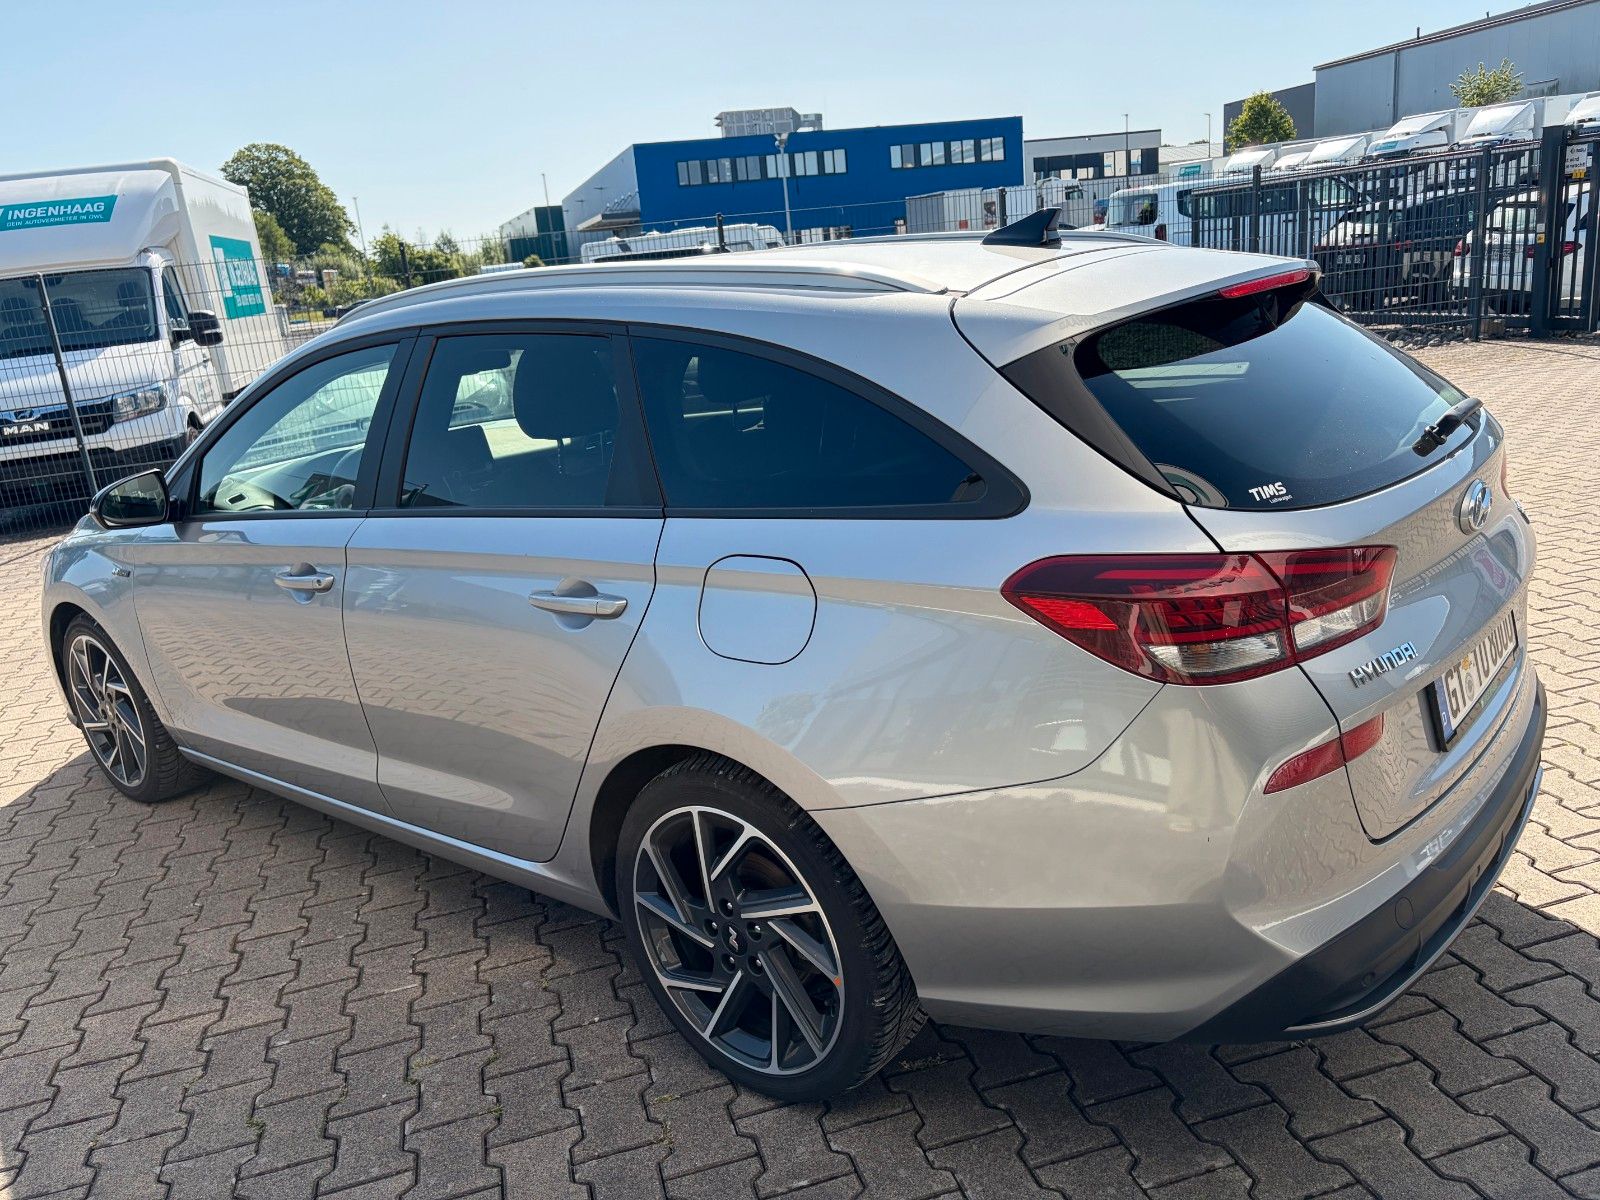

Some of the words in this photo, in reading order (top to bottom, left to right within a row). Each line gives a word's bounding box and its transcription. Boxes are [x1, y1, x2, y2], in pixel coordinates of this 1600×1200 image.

[8, 202, 105, 220] INGENHAAG
[25, 215, 78, 225] AUTOVERMIETER
[3, 422, 49, 435] MAN
[1248, 481, 1287, 501] TIMS
[1349, 641, 1418, 688] HYUNDAI
